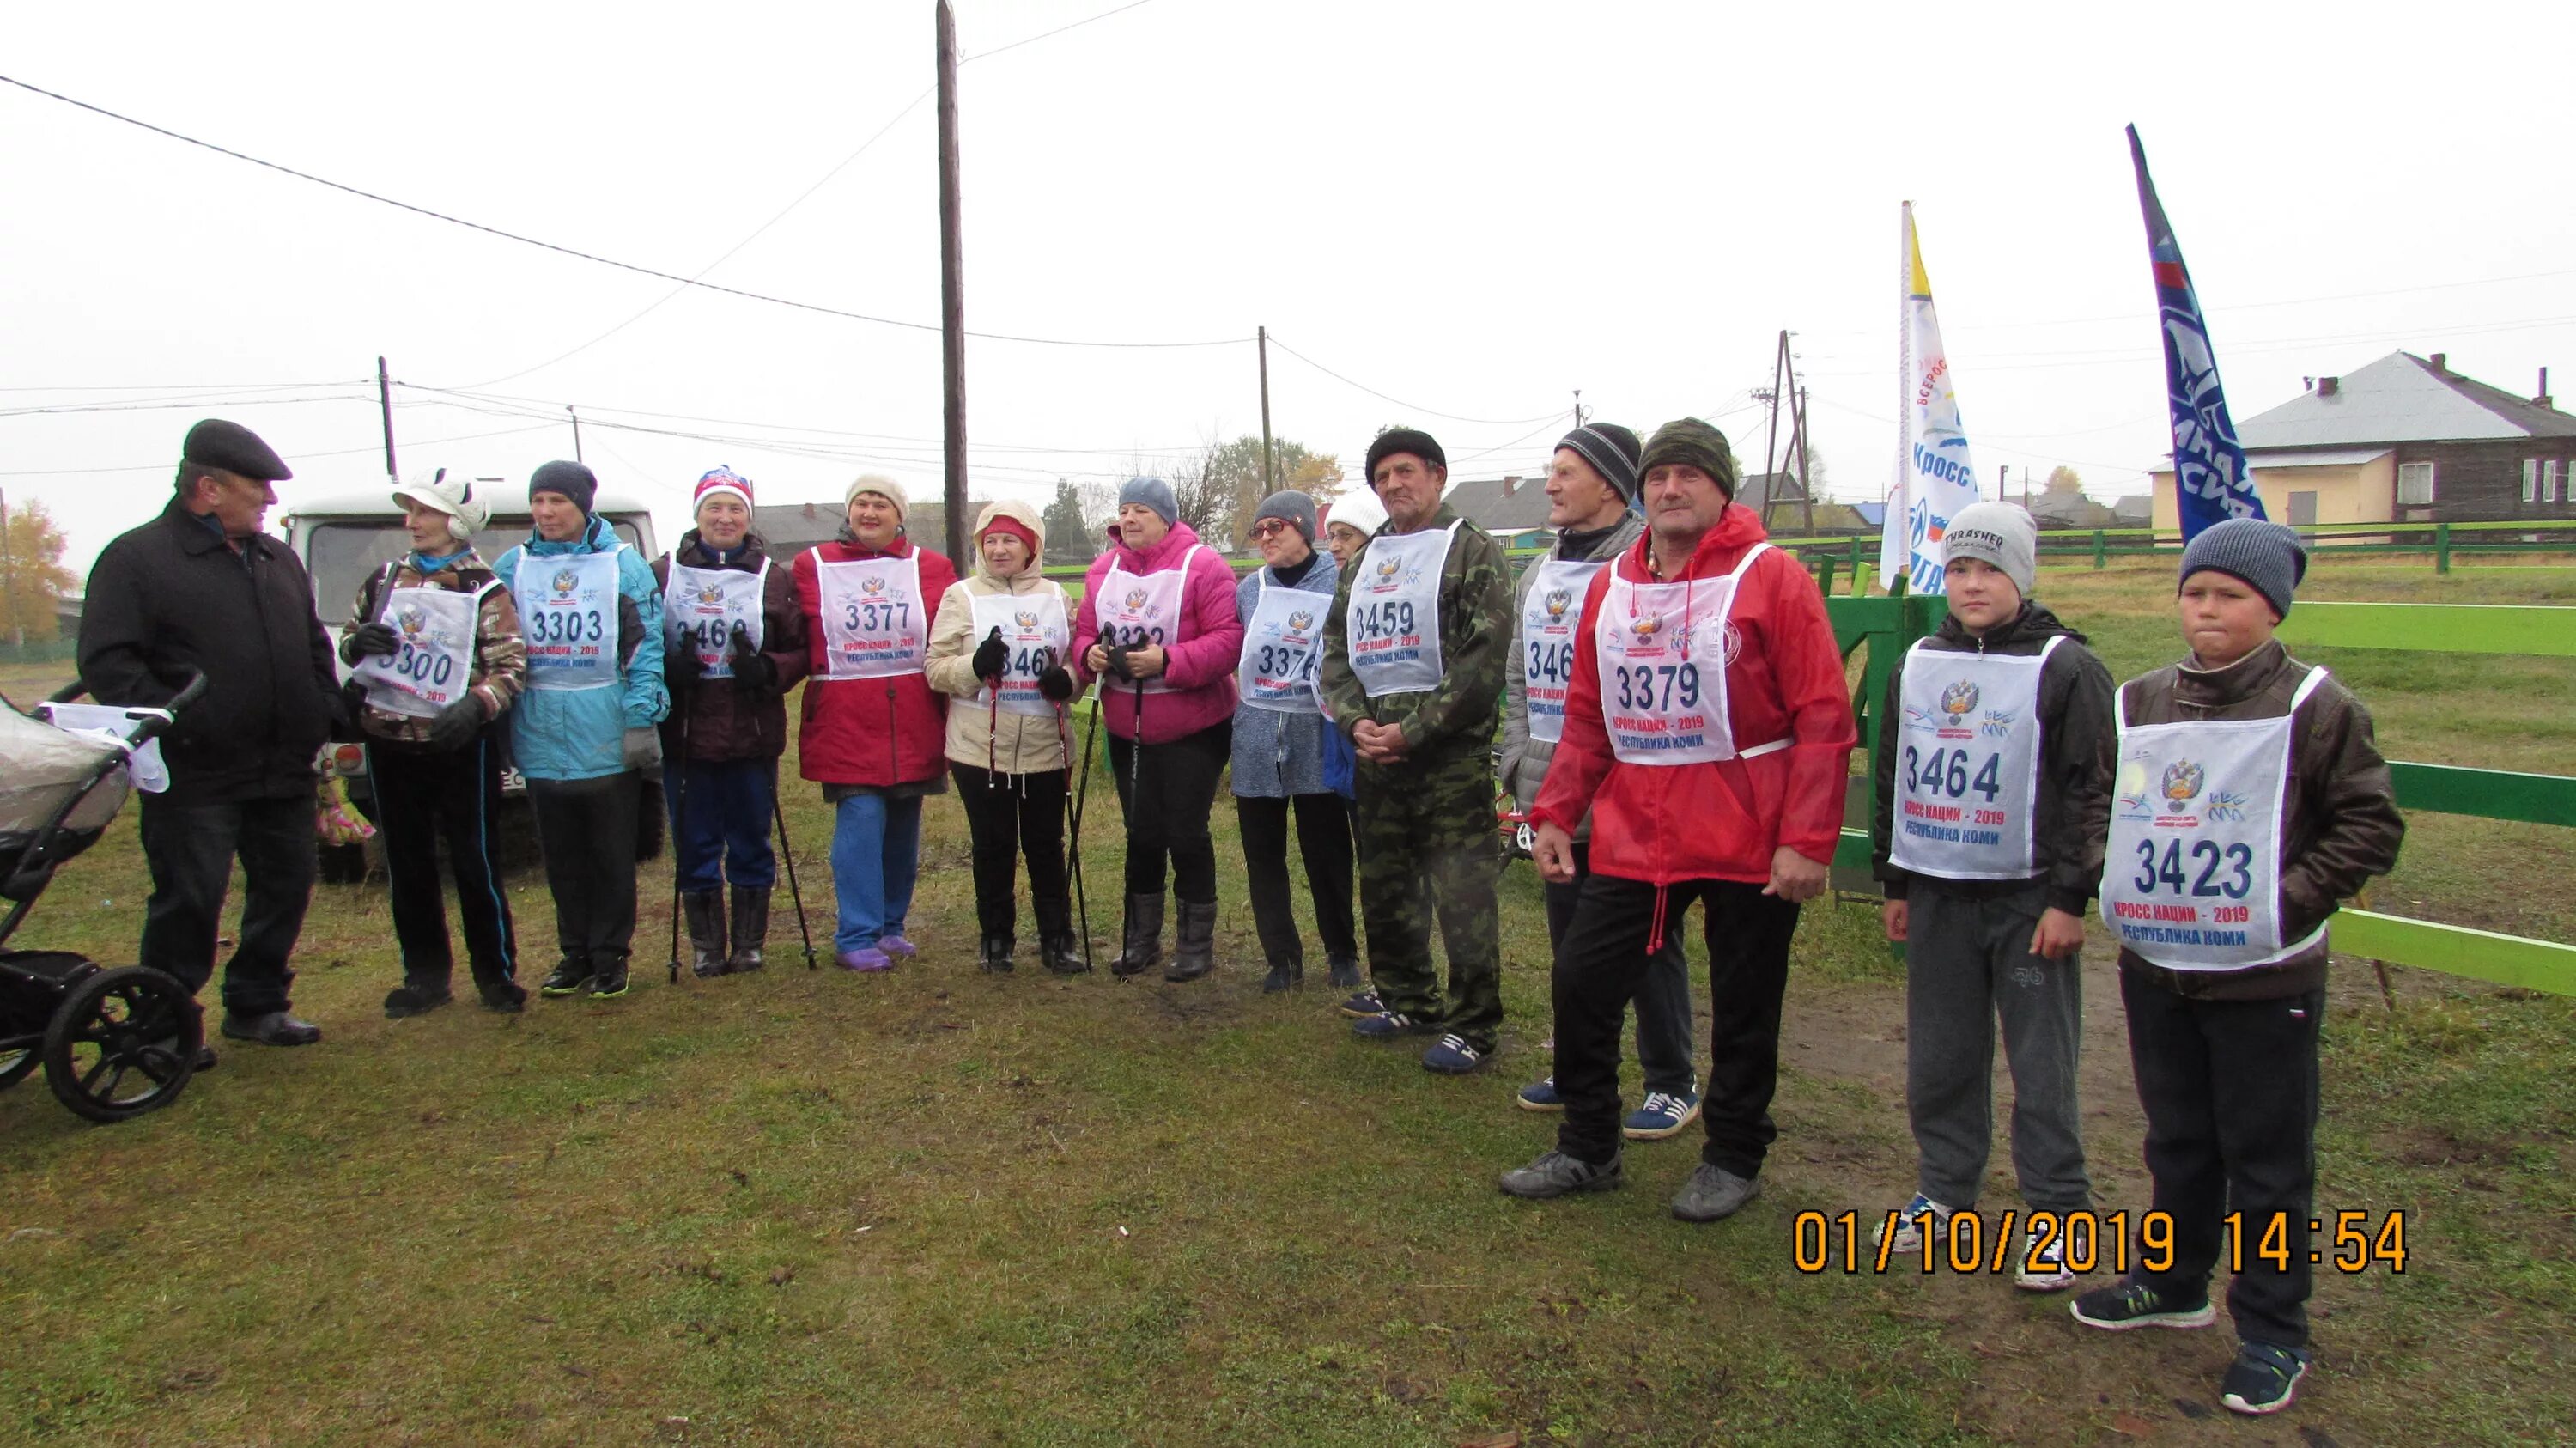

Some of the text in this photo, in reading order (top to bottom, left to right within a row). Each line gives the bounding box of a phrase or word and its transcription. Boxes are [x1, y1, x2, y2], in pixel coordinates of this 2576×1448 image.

[1913, 441, 1970, 487] Кросс
[1945, 528, 2003, 551] THRASHER
[532, 610, 603, 642] 3303
[845, 602, 909, 631] 3377
[1356, 601, 1413, 641] 3459
[580, 645, 599, 655] 2019
[1400, 635, 1419, 646] 2019
[1002, 646, 1057, 676] 346
[1616, 662, 1699, 712] 3379
[1677, 715, 1704, 730] 2019
[1905, 745, 2000, 803] 3464
[1925, 804, 1961, 822] НАЦИИ
[1974, 809, 2005, 825] 2019
[1961, 829, 1999, 845] КОМИ
[2134, 837, 2252, 899] 3423
[2113, 901, 2151, 920] КРОСС
[2154, 904, 2196, 924] НАЦИИ
[2213, 905, 2249, 923] 2019
[2203, 930, 2245, 946] КОМИ
